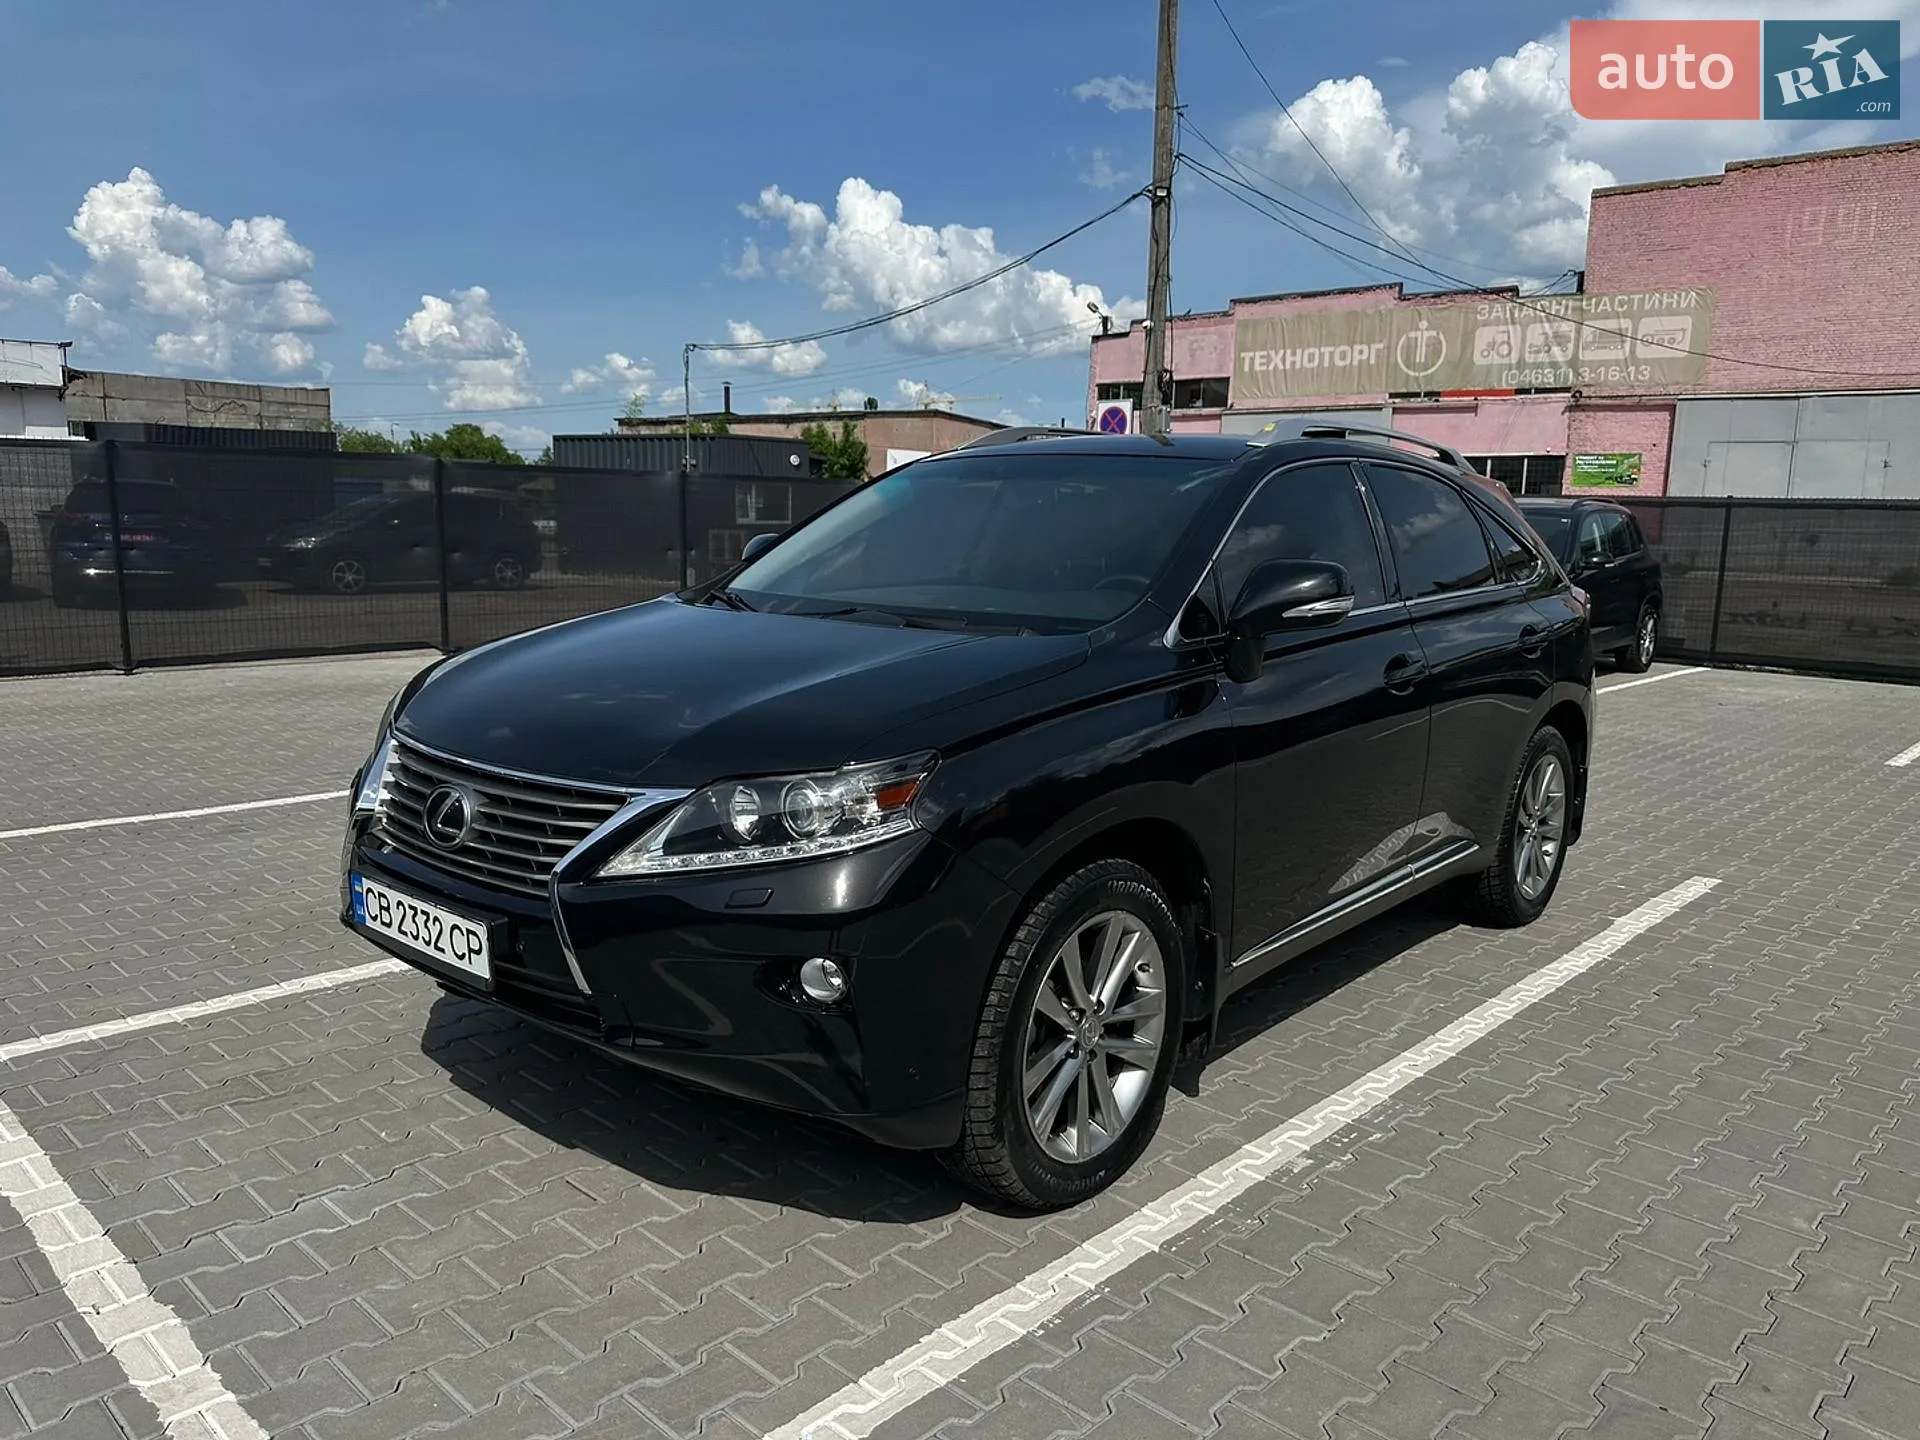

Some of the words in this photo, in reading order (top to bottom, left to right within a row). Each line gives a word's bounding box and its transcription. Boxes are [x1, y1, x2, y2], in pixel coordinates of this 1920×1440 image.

[1476, 300, 1573, 321] ЗАПАСНІ
[1582, 292, 1697, 315] ЧАСТИНИ
[1240, 343, 1385, 373] ТЕХНОТОРГ
[1502, 367, 1573, 386] (04631)
[1578, 366, 1651, 383] 3-16-13
[365, 886, 393, 929] CB
[396, 899, 446, 954] 2332
[449, 923, 483, 966] CP
